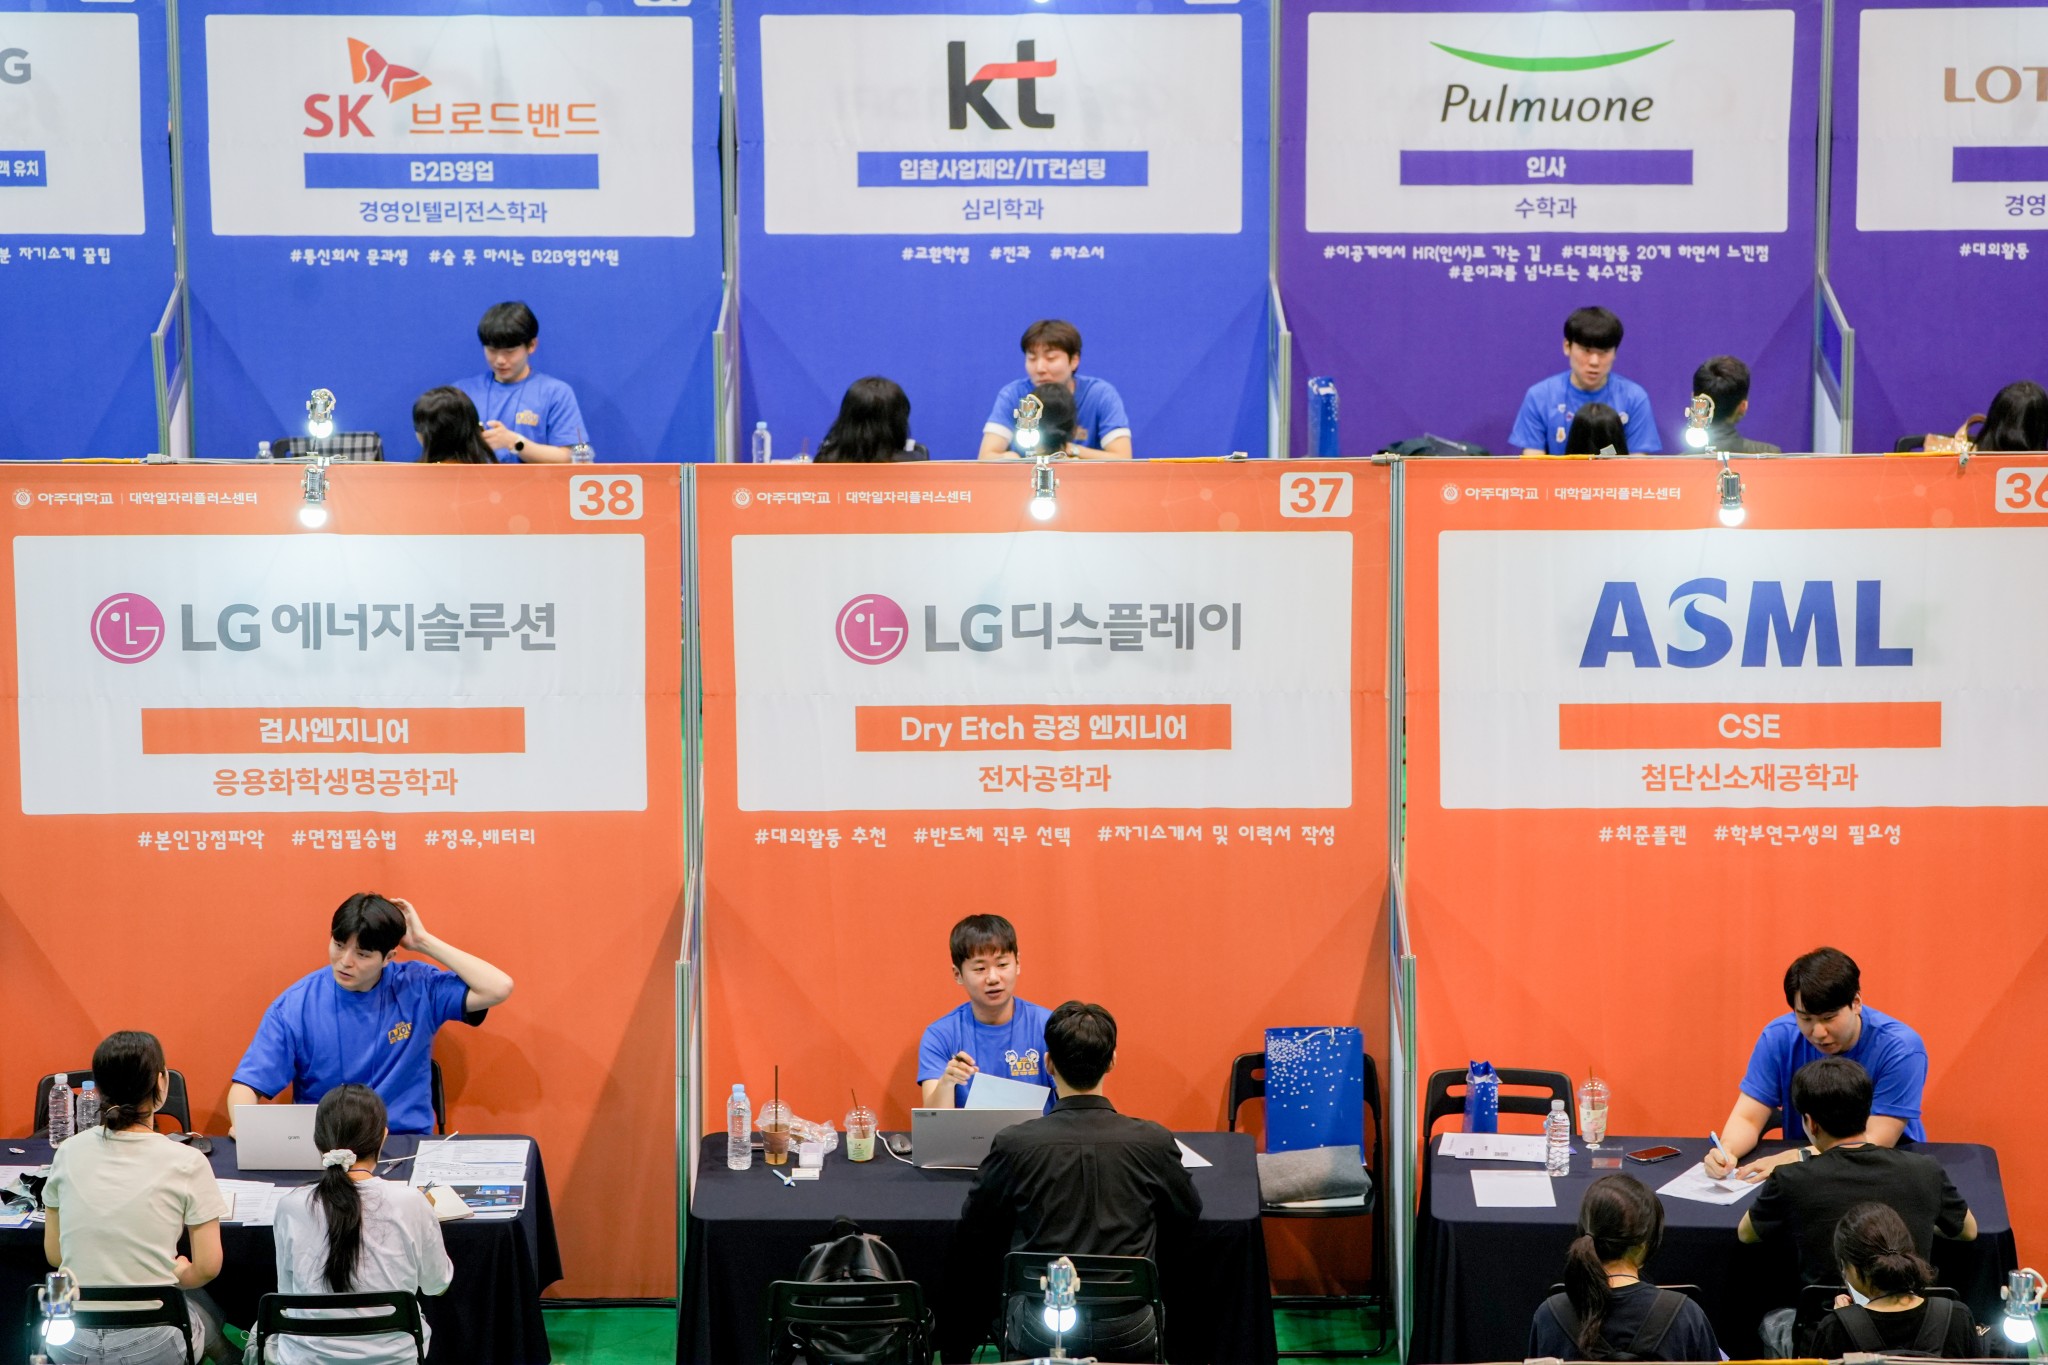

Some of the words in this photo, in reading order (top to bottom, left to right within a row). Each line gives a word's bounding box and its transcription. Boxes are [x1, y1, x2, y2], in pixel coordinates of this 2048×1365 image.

[947, 39, 1057, 130] kt
[1441, 84, 1653, 122] Pulmuone
[303, 94, 374, 137] SK
[409, 103, 599, 138] 브로드밴드
[14, 160, 38, 177] 유치
[410, 161, 493, 182] B2B영업
[900, 158, 1105, 180] 입찰사업제안/IT컨설팅
[1527, 156, 1566, 178] 인사
[360, 201, 547, 223] 경영인텔리전스학과
[963, 198, 1044, 220] 심리학과
[1515, 197, 1577, 219] 수학과
[2005, 194, 2045, 216] 경영
[19, 247, 75, 260] 자기소개
[83, 248, 110, 264] 꿀팁
[290, 249, 360, 266] #통신회사
[366, 249, 408, 266] 문과생
[429, 249, 455, 266] #술
[462, 249, 476, 265] 못
[484, 249, 525, 266] 마시는
[532, 249, 619, 266] B2B영업사원
[902, 246, 969, 264] #교환학생
[990, 246, 1031, 263] #전과
[1050, 246, 1104, 259] #자소서
[1324, 245, 1406, 262] #이공계에서
[1413, 245, 1486, 263] HR(인사)로
[1492, 245, 1520, 262] 가는
[1527, 245, 1540, 262] 길
[1562, 245, 1630, 262] #대외활동
[1637, 245, 1671, 260] 20개
[1678, 245, 1720, 262] 하면서
[1727, 245, 1769, 262] 느낀점
[1960, 242, 2029, 260] #대외활동
[1449, 265, 1517, 282] #문이과를
[1524, 264, 1580, 281] 넘나드는
[1587, 265, 1643, 282] 복수전공
[38, 493, 114, 505] 아주대학교
[130, 492, 258, 505] 대학일자리플러스센터
[580, 480, 634, 516] 38
[757, 492, 831, 504] 아주대학교
[846, 490, 972, 504] 대학일자리플러스센터
[1291, 478, 1343, 513] 37
[1465, 487, 1539, 500] 아주대학교
[1555, 487, 1681, 500] 대학일자리플러스센터
[181, 604, 260, 651] LG
[272, 603, 556, 652] 에너지솔루션
[925, 604, 1002, 652] LG
[1012, 603, 1241, 651] 디스플레이
[1579, 578, 1913, 668] ASML
[260, 718, 408, 743] 검사엔지니어
[901, 717, 952, 747] Dry
[961, 715, 1024, 740] Etch
[1033, 715, 1080, 740] 공정
[1089, 715, 1186, 740] 엔지니어
[1718, 714, 1780, 739] CSE
[213, 768, 458, 796] 응용화학생명공학과
[979, 764, 1111, 792] 전자공학과
[1642, 763, 1858, 792] 첨단신소재공학과
[138, 830, 265, 851] #본인강점파악
[292, 829, 396, 850] #면접필승법
[425, 828, 535, 849] #정유,배터리
[755, 828, 842, 848] #대외활동
[852, 827, 886, 848] 추천
[914, 826, 983, 847] #반도체
[993, 826, 1027, 846] 직무
[1037, 826, 1070, 847] 선택
[1098, 825, 1202, 841] #자기소개서
[1213, 825, 1228, 845] 및
[1238, 826, 1290, 845] 이력서
[1302, 826, 1334, 846] 작성
[1599, 825, 1686, 846] #취준플랜
[1714, 825, 1837, 846] #학부연구생의
[1849, 824, 1900, 845] 필요성
